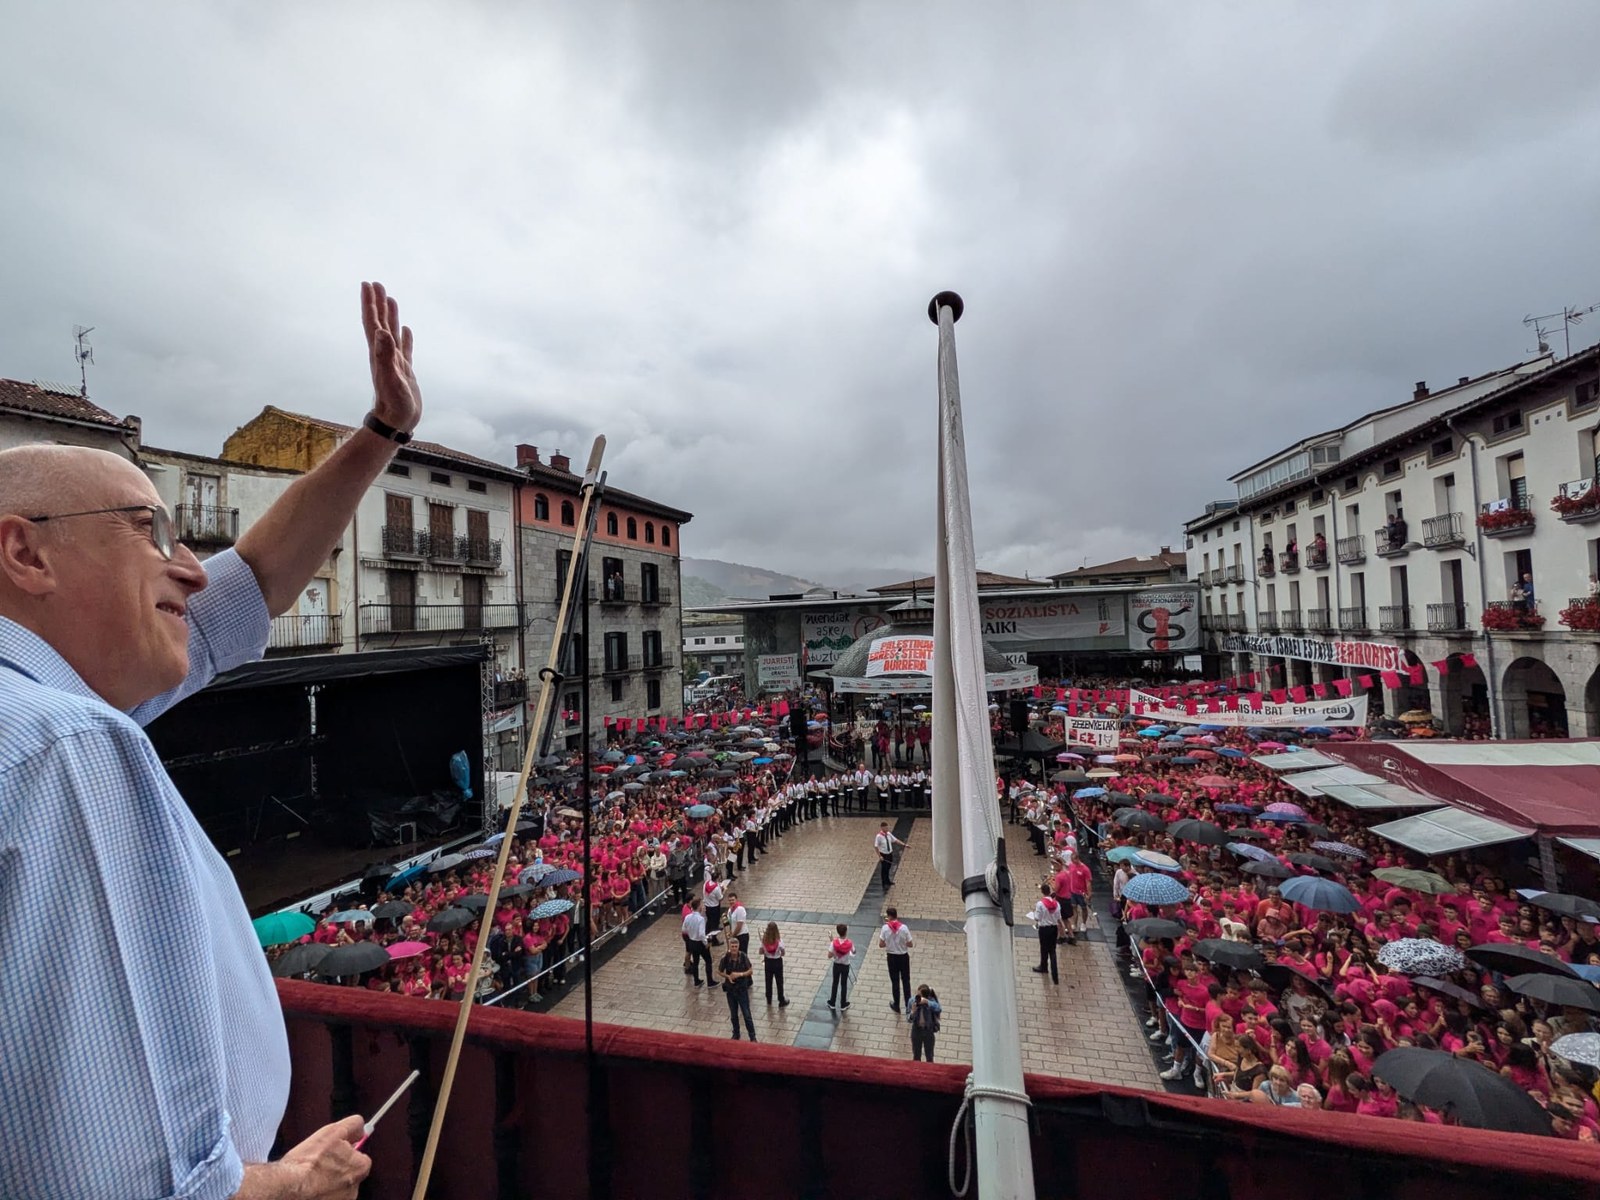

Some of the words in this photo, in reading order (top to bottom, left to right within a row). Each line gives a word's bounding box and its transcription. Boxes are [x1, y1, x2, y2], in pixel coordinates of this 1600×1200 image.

[985, 604, 1080, 620] SOZIALISTA
[1276, 637, 1301, 657] ISRAEL
[1303, 639, 1333, 662] ESTATU
[1335, 642, 1403, 671] TERRORIST
[883, 660, 927, 672] AURRERA
[1265, 706, 1282, 716] BAT
